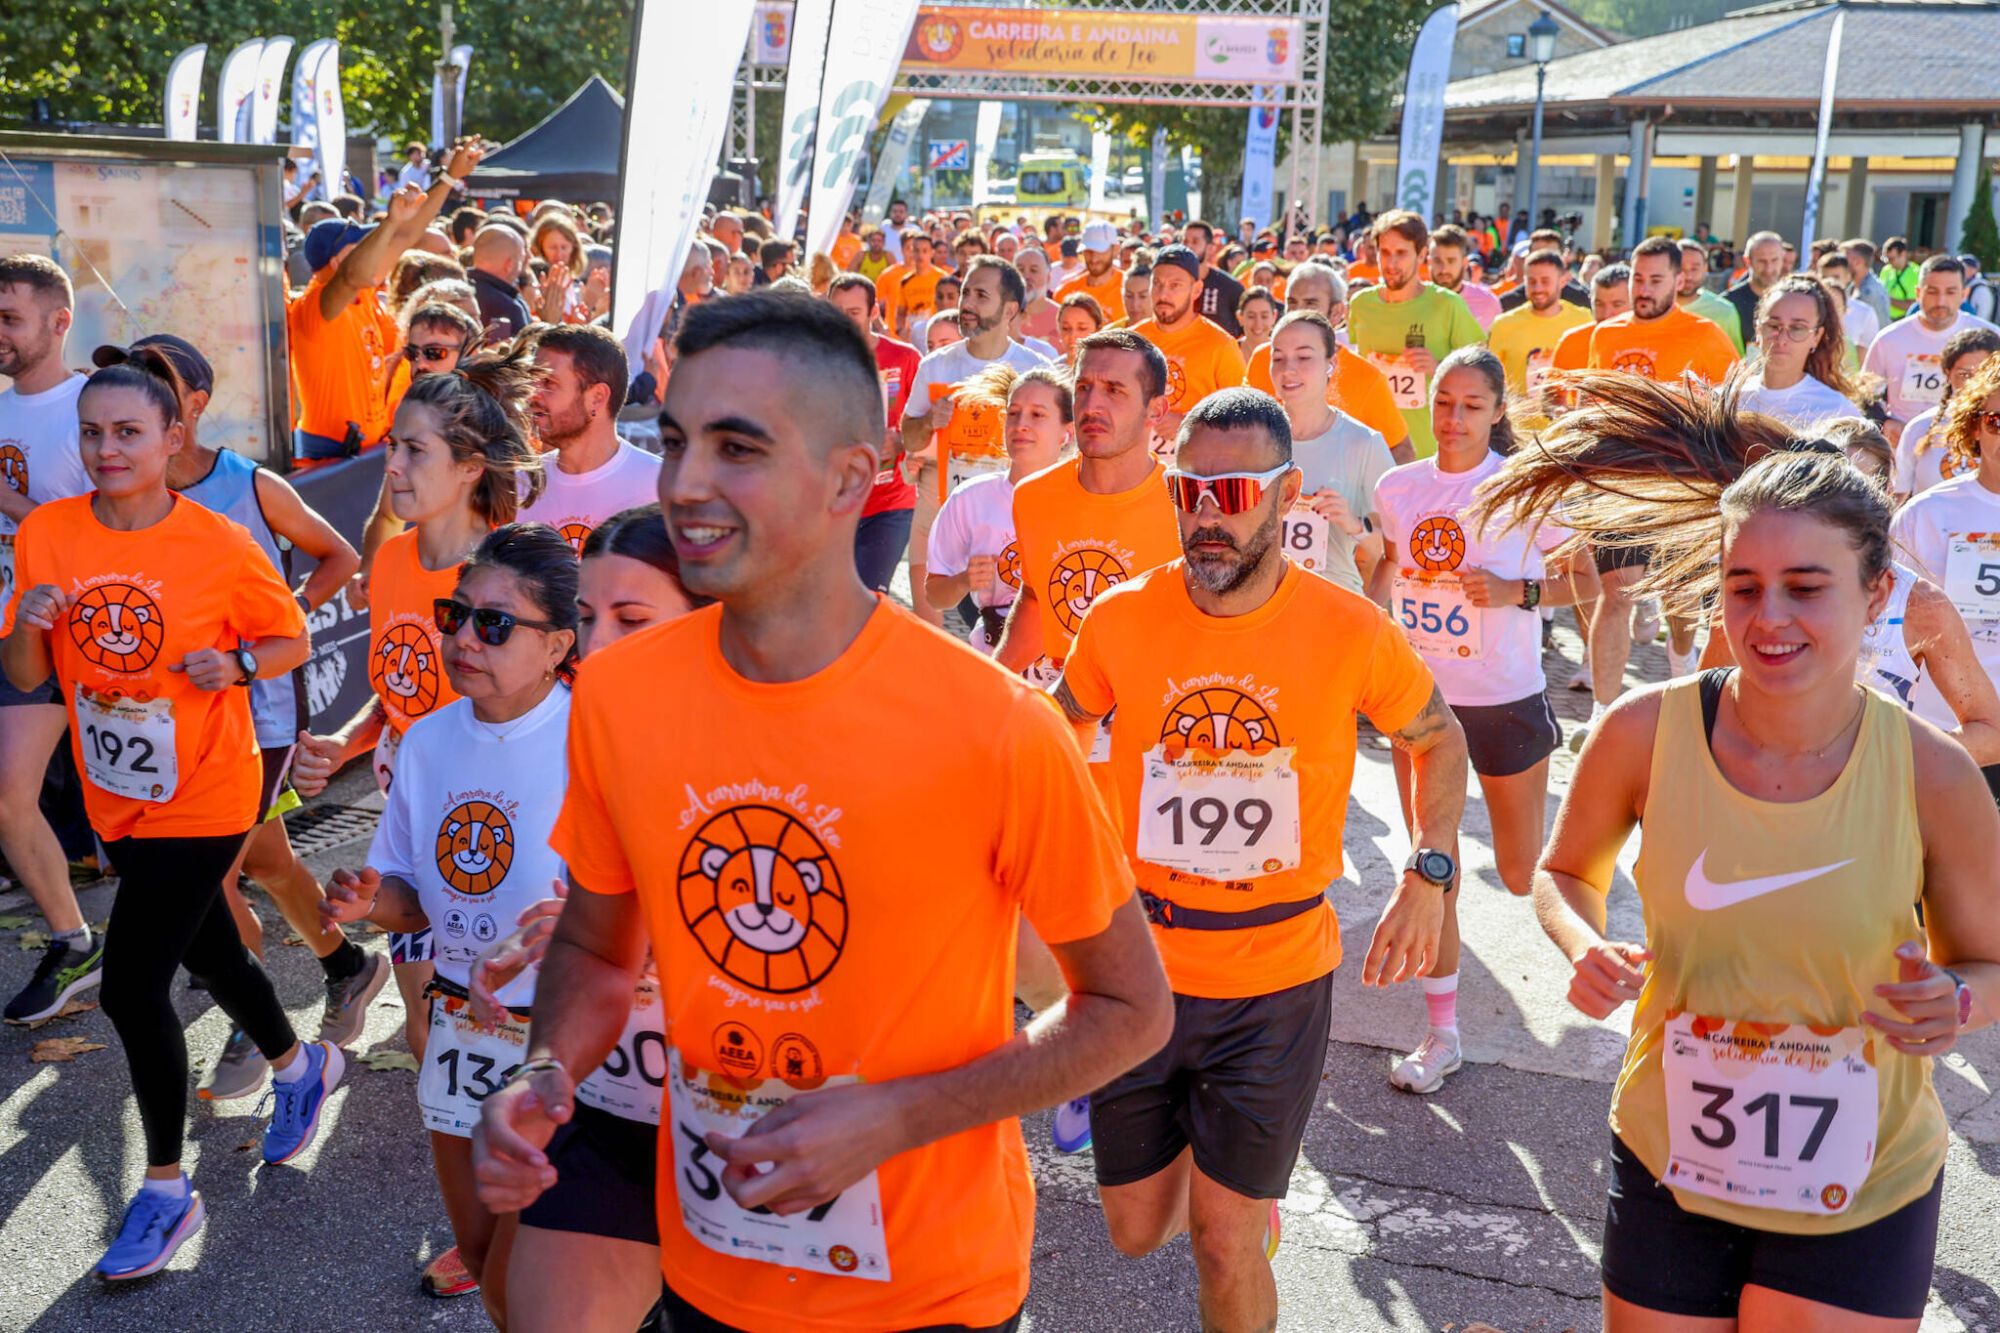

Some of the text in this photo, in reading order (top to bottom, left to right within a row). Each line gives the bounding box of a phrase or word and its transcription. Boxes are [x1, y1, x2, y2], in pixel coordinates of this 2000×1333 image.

[968, 21, 1180, 45] CARREIRA E ANDAINA
[986, 36, 1159, 71] solidaria de Leo
[1400, 597, 1469, 637] 556
[1181, 671, 1237, 691] carreira
[86, 724, 159, 774] 192
[1176, 759, 1217, 769] CARREIRA
[677, 777, 843, 849] A carreira de Leo
[1156, 796, 1273, 847] 199
[718, 1045, 756, 1062] AEEA
[1711, 1034, 1766, 1049] CARREIRA
[1769, 1040, 1775, 1050] E
[1779, 1041, 1832, 1054] ANDAINA
[1712, 1045, 1779, 1065] solidaria
[1784, 1049, 1804, 1067] de
[1690, 1080, 1839, 1162] 317
